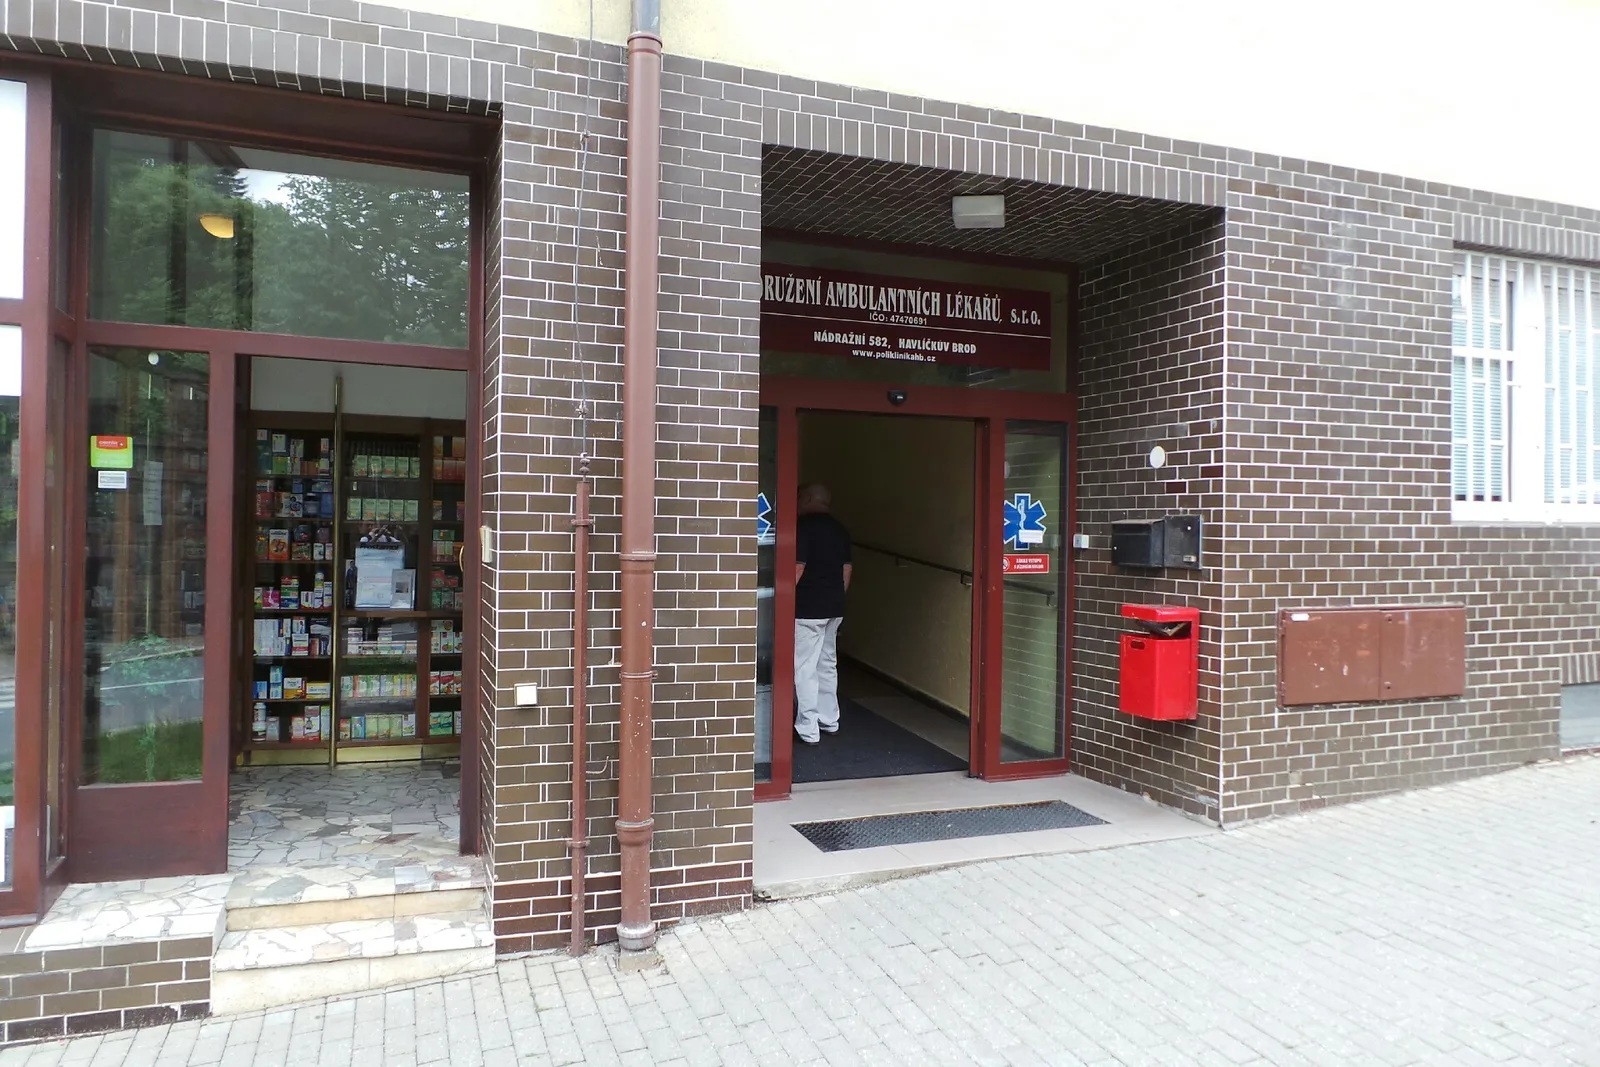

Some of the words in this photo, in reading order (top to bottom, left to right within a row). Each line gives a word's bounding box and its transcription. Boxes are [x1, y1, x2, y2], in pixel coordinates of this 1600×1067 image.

[825, 281, 941, 316] AMBULANTNÍCH
[869, 312, 888, 322] IČO:
[889, 314, 927, 326] 47470691
[814, 330, 866, 345] NÁDRAŽNÍ
[868, 335, 892, 349] 582,
[951, 343, 977, 354] BROD
[852, 349, 937, 363] www.poliklinikahb.cz
